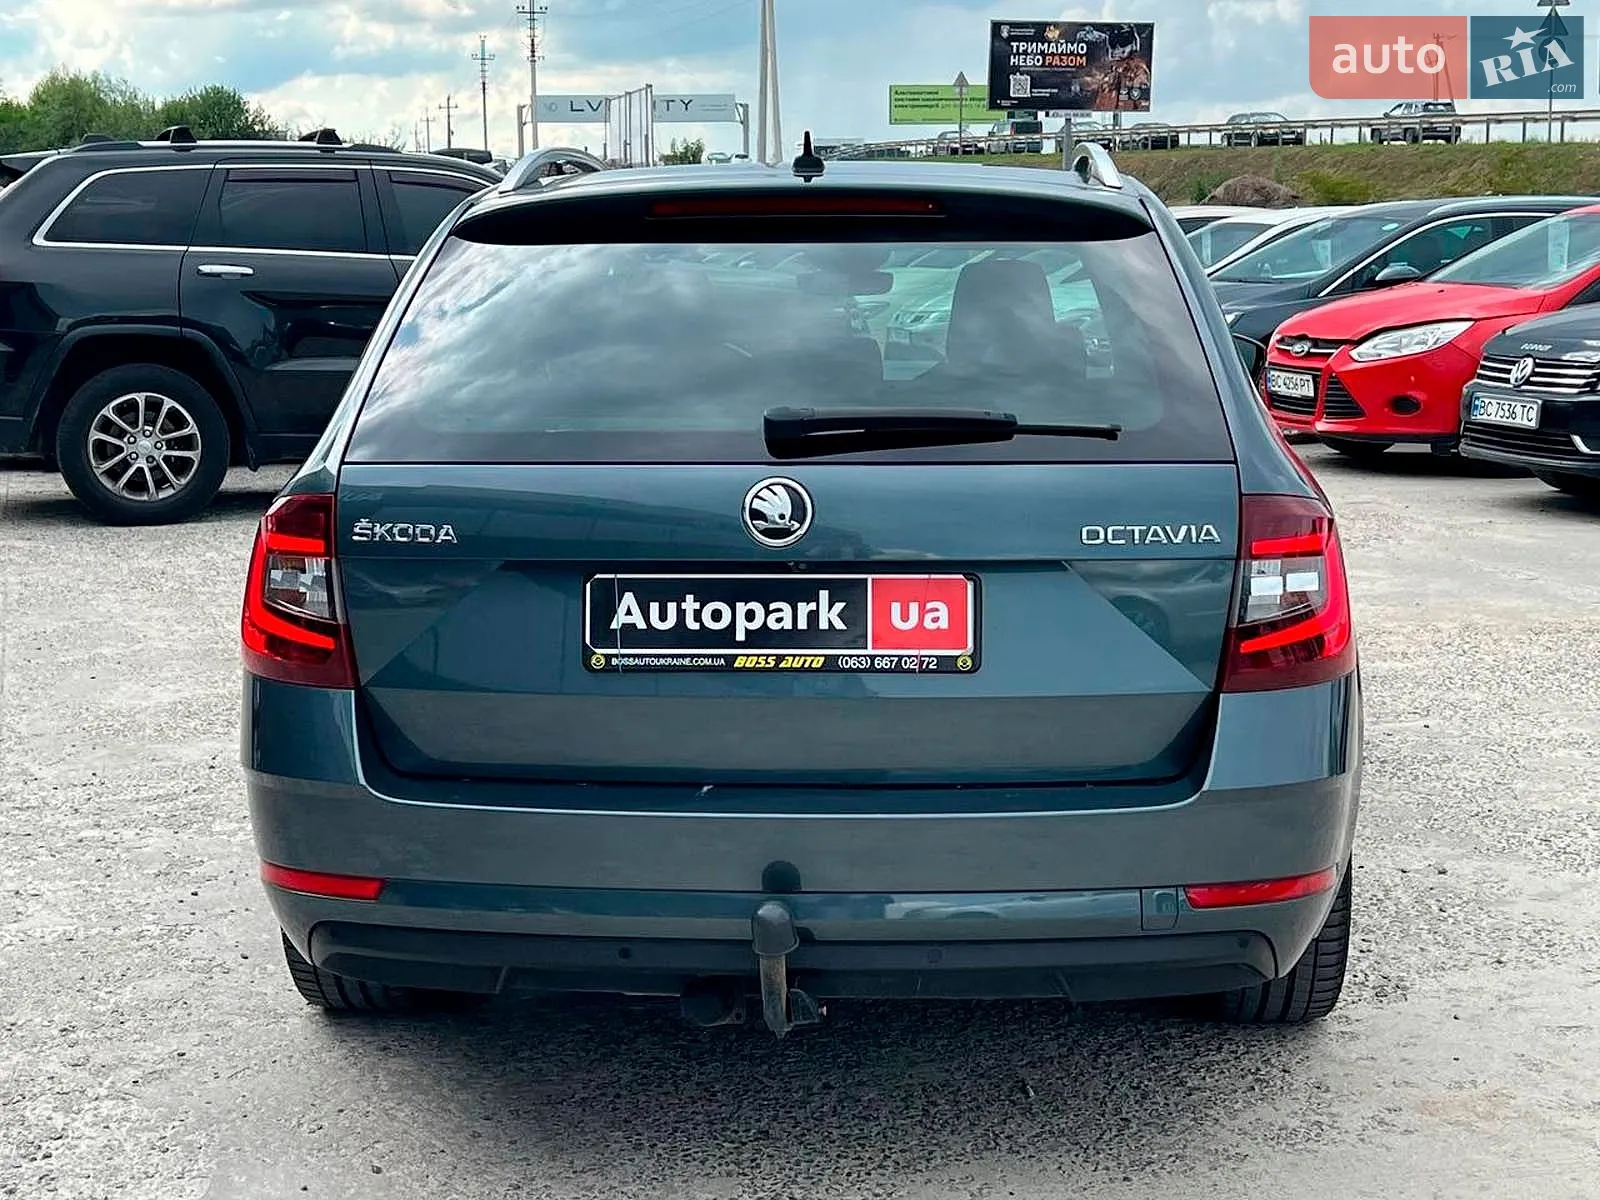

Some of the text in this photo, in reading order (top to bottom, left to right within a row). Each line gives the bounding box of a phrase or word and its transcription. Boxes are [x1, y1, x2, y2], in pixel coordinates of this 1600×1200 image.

[1010, 40, 1087, 53] ТРИМАЙМО
[1010, 55, 1087, 66] НЕБО РАЗОМ
[1479, 400, 1535, 423] BC 7536 TC
[352, 518, 458, 543] ŠKODA
[1081, 524, 1221, 545] OCTAVIA
[610, 590, 950, 642] Autopark ua
[734, 656, 776, 668] BOSS
[779, 656, 826, 668] AUTO
[837, 656, 871, 669] (063)
[874, 657, 897, 669] 667
[901, 657, 918, 669] 02
[921, 657, 938, 669] 72
